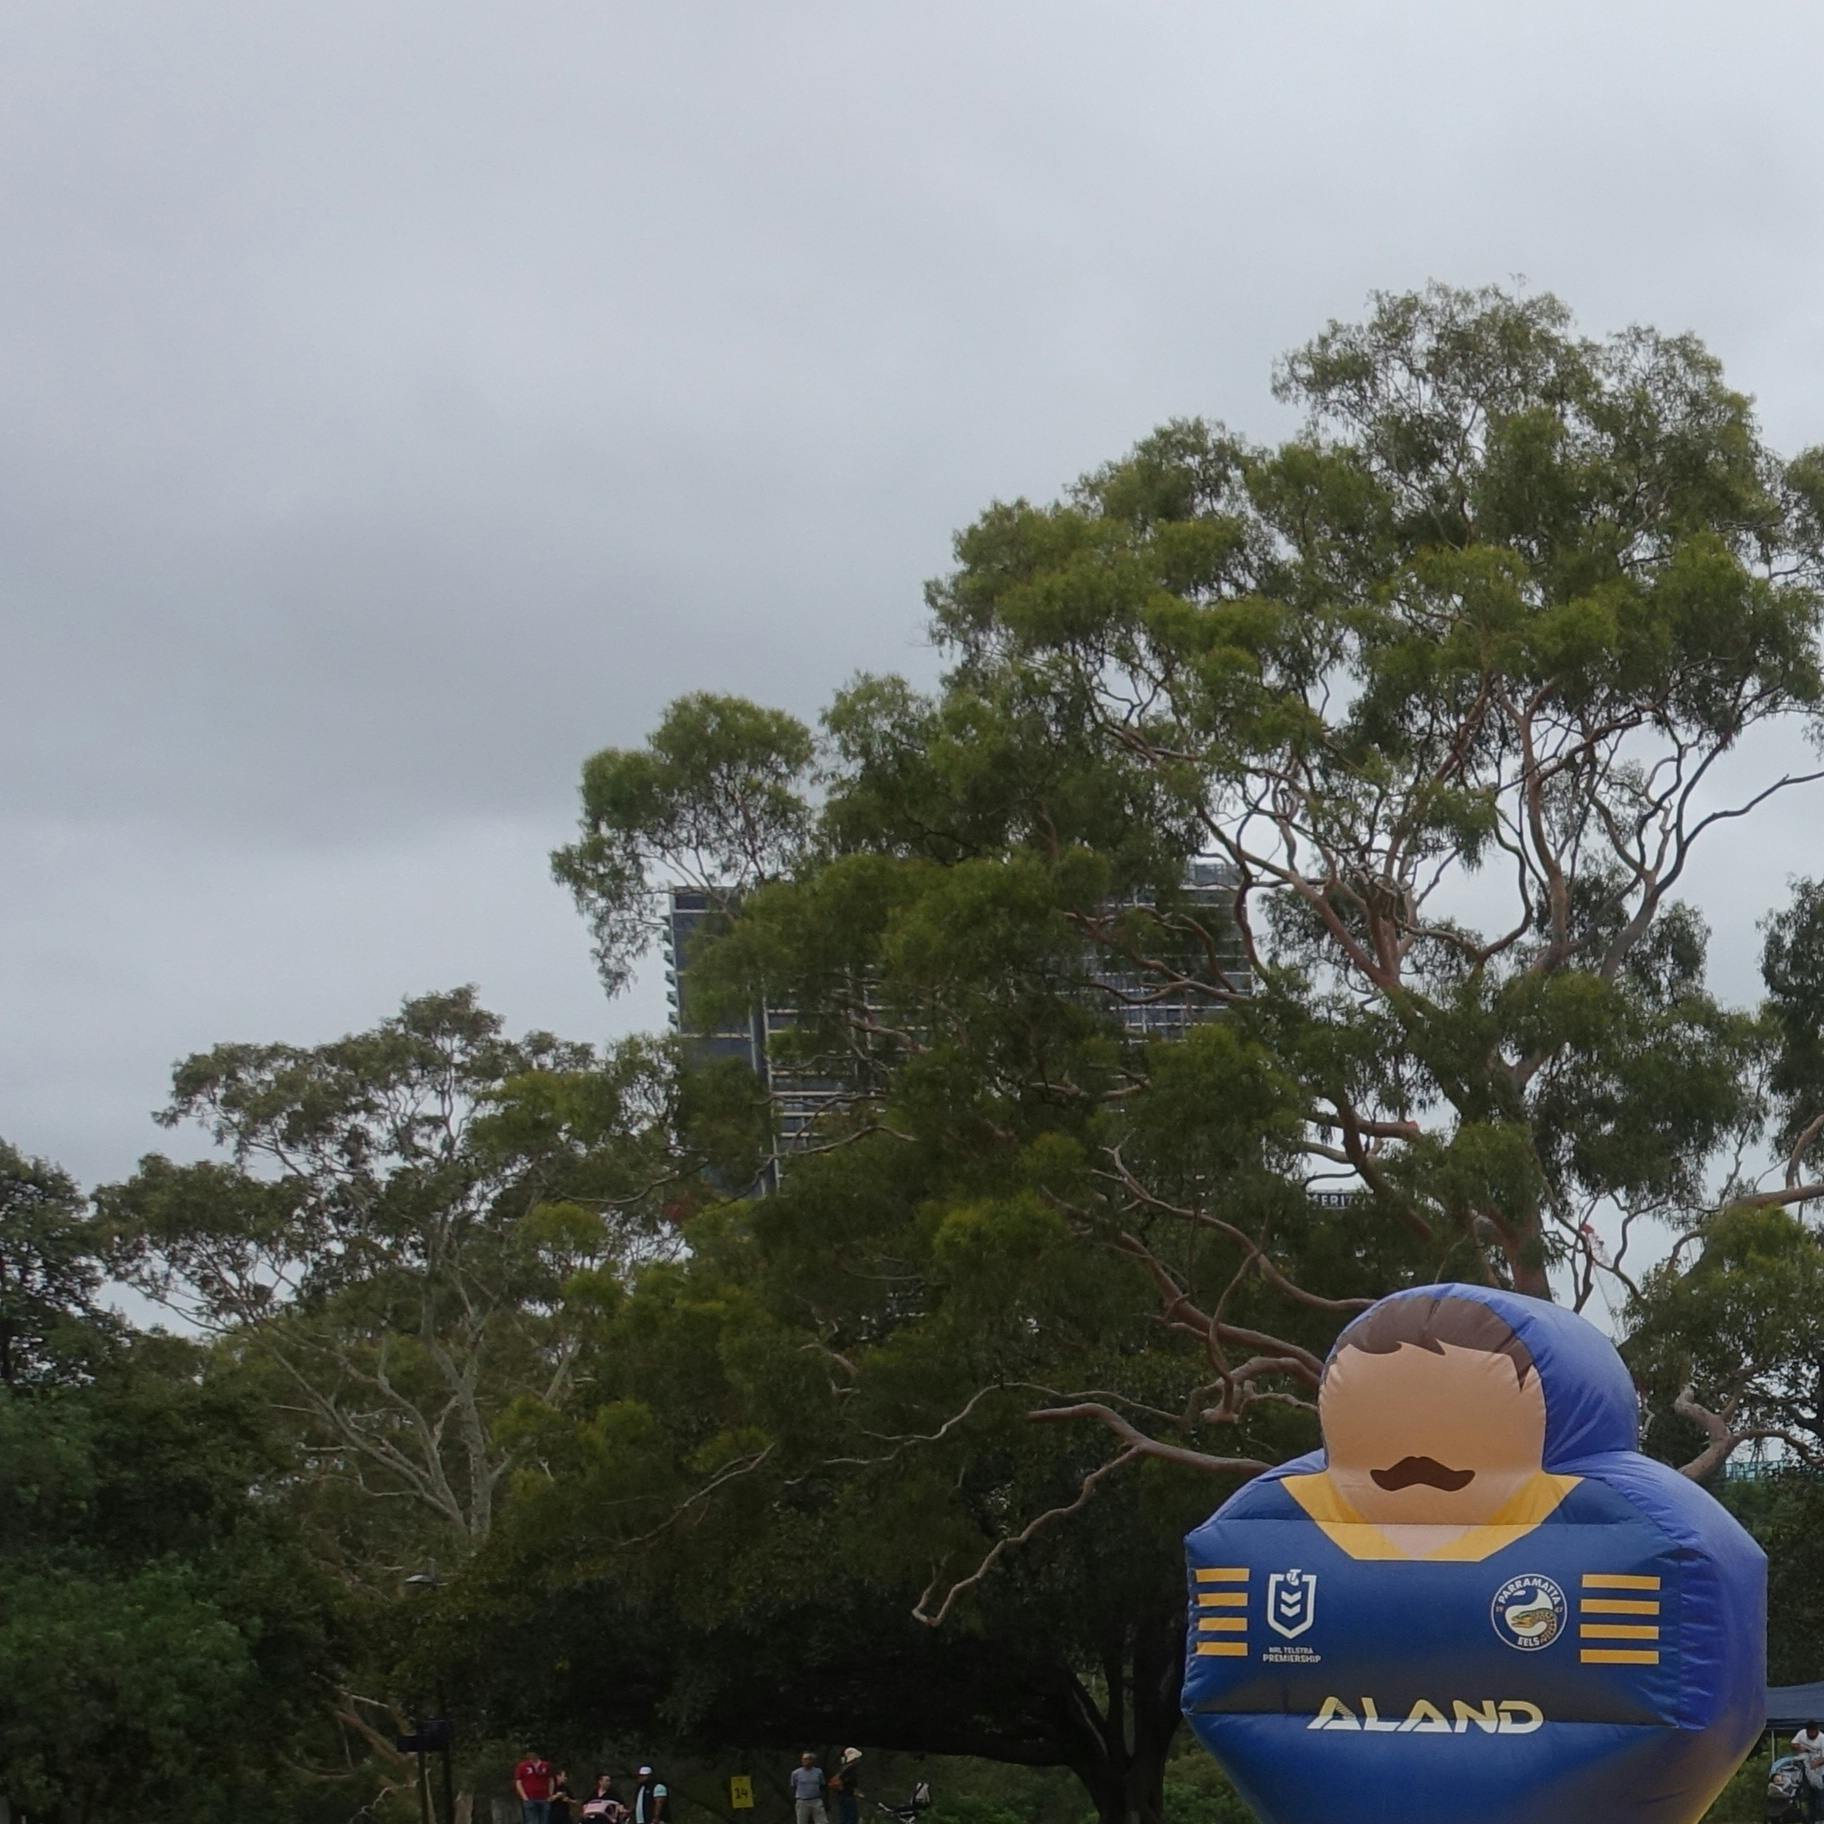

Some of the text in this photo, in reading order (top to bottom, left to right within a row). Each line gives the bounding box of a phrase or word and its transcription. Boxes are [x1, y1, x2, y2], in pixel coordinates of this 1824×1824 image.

[1498, 1577, 1562, 1605] PARRAMATTA
[1517, 1636, 1541, 1647] EELS
[1263, 1653, 1322, 1663] PREMIERSHIP
[1306, 1696, 1545, 1734] ALAND
